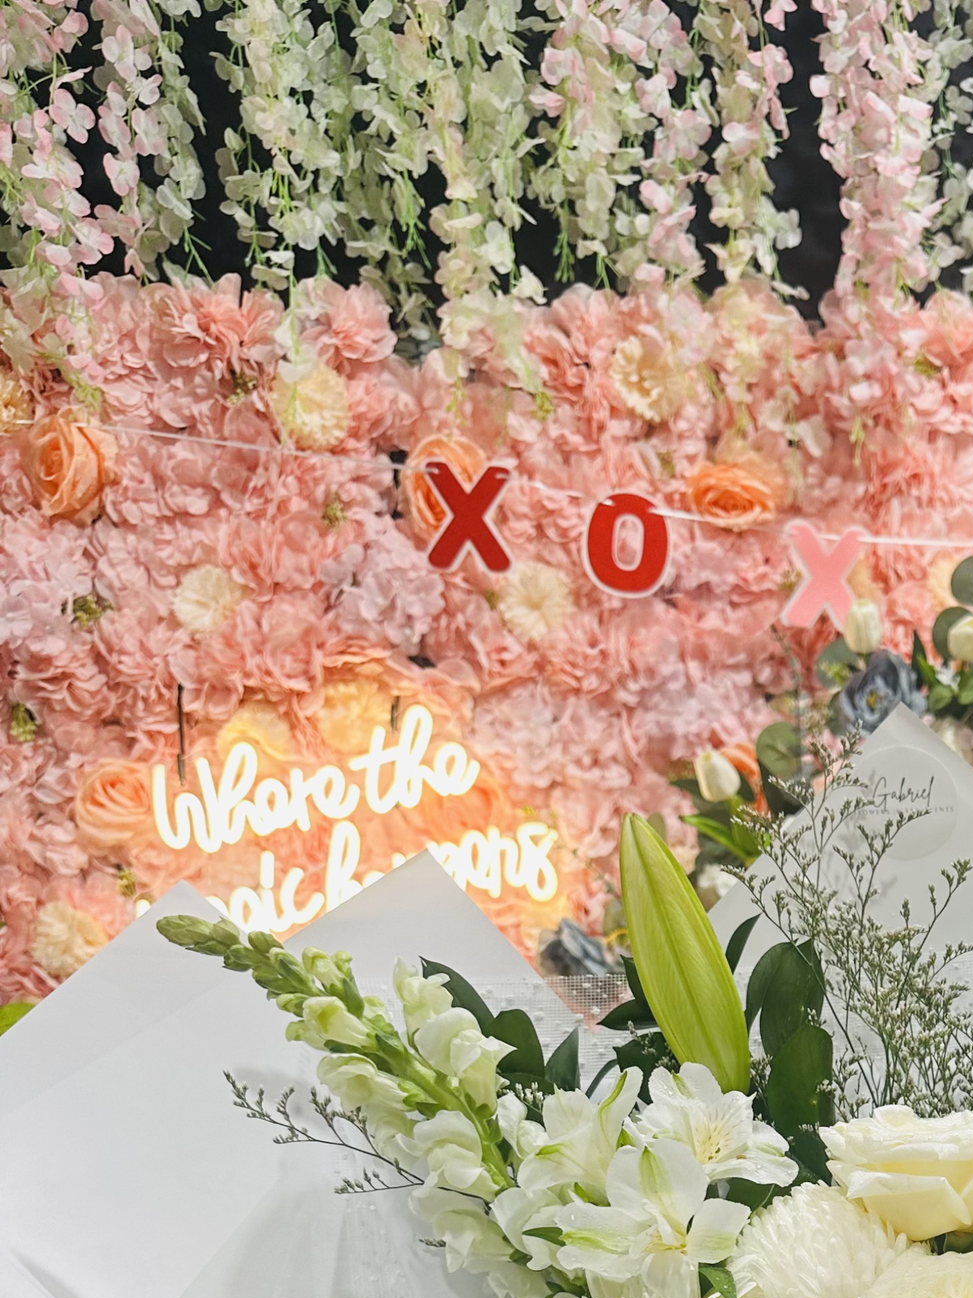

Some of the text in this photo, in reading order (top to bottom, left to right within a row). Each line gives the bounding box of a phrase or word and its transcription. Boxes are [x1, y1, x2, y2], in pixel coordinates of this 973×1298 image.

[152, 704, 481, 853] Where the
[872, 776, 935, 812] Gabriel
